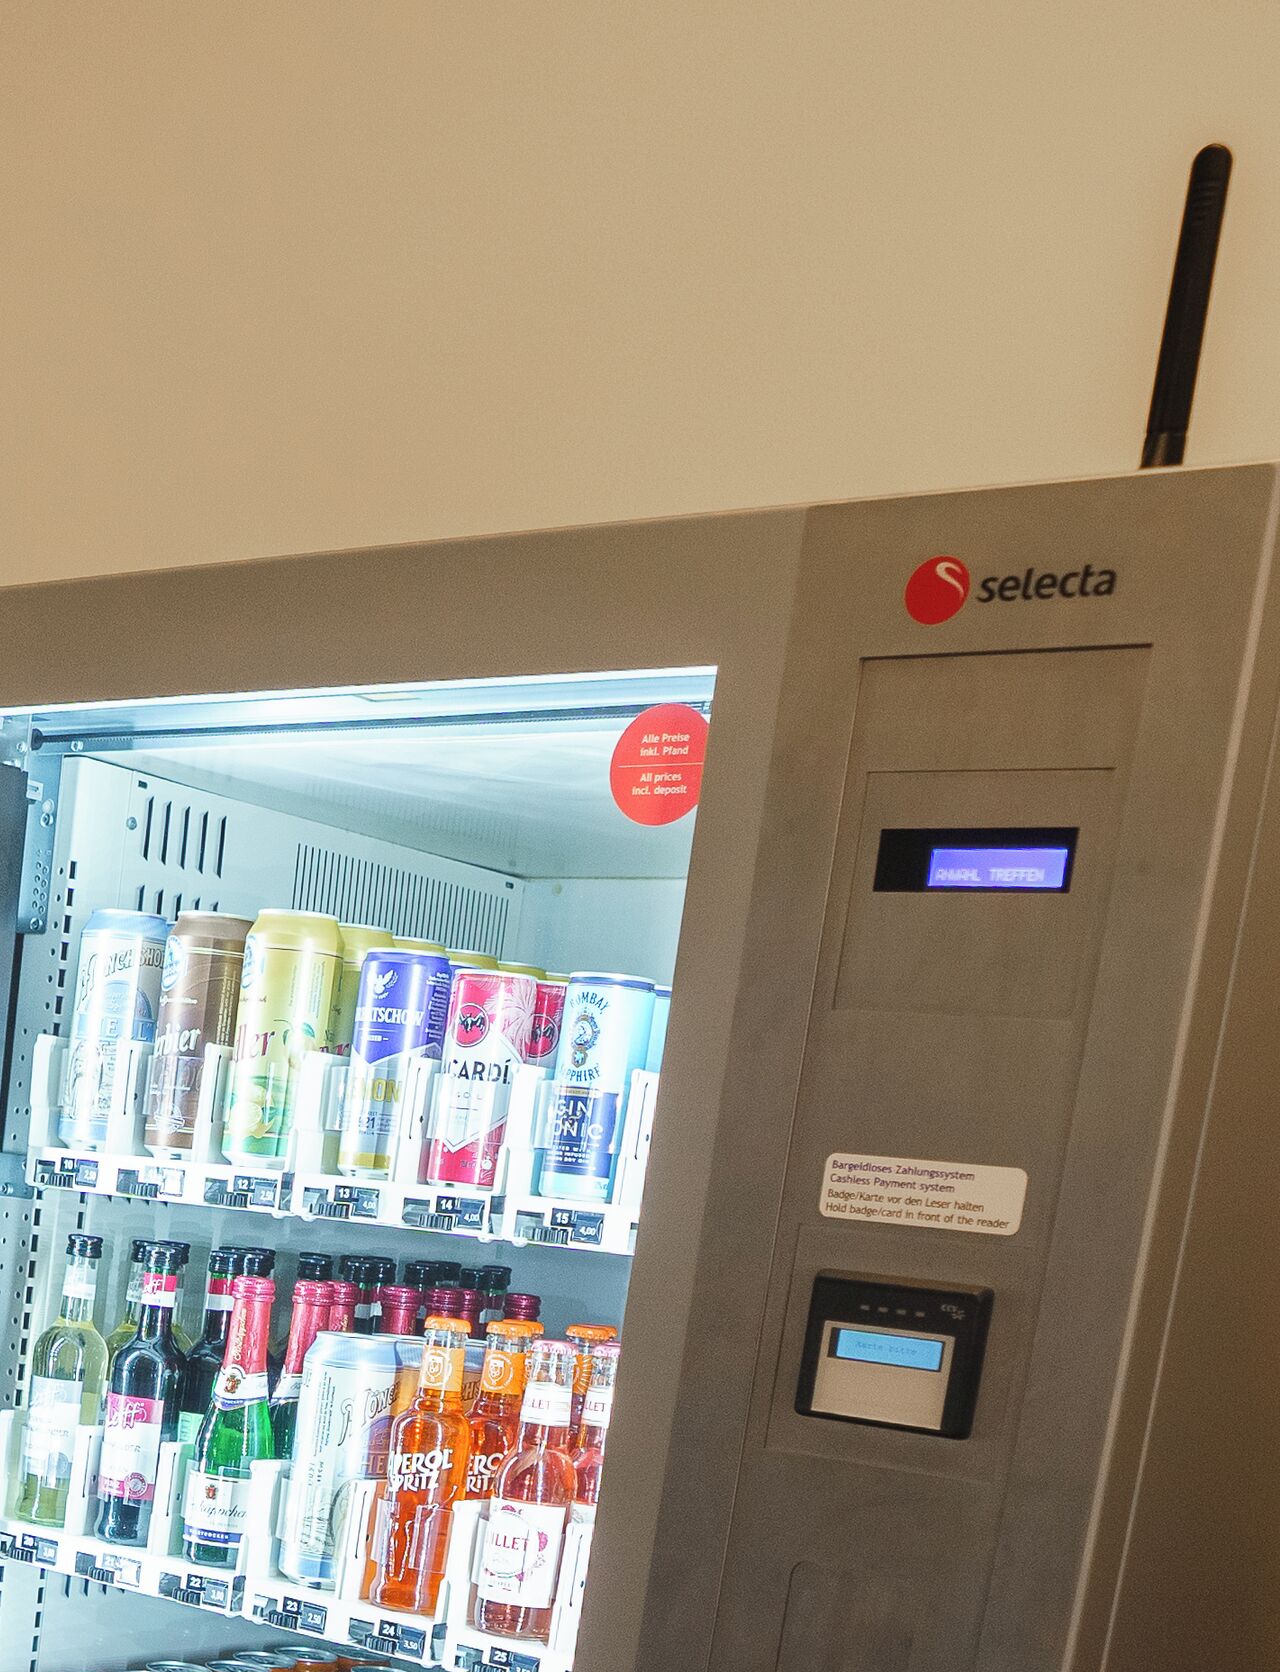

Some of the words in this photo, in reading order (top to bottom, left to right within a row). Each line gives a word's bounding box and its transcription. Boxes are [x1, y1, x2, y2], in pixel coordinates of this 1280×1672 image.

[977, 562, 1118, 603] selecta
[642, 734, 660, 744] Alle
[661, 732, 690, 743] Preise
[662, 745, 689, 756] Pfand
[640, 772, 652, 782] All
[654, 772, 682, 784] prices
[654, 784, 687, 797] deposit
[831, 1160, 893, 1175] Bargeldloses
[895, 1164, 975, 1182] Zahlungssystem
[830, 1174, 871, 1187] Cashless
[873, 1177, 917, 1191] Payment
[919, 1182, 956, 1193] system
[338, 1188, 349, 1198] 13
[441, 1200, 452, 1210] 14
[887, 1195, 902, 1204] vor
[905, 1195, 923, 1206] den
[925, 1197, 951, 1209] Leser
[953, 1199, 985, 1213] halten
[555, 1212, 569, 1223] 15
[825, 1202, 847, 1214] Hold
[849, 1204, 903, 1219] badge/card
[905, 1208, 914, 1218] in
[916, 1209, 941, 1222] front
[943, 1212, 955, 1223] of
[957, 1214, 974, 1225] the
[976, 1218, 1010, 1230] reader
[190, 1577, 201, 1588] 22
[286, 1601, 298, 1612] 23
[383, 1624, 396, 1635] 24
[493, 1650, 507, 1662] 25
